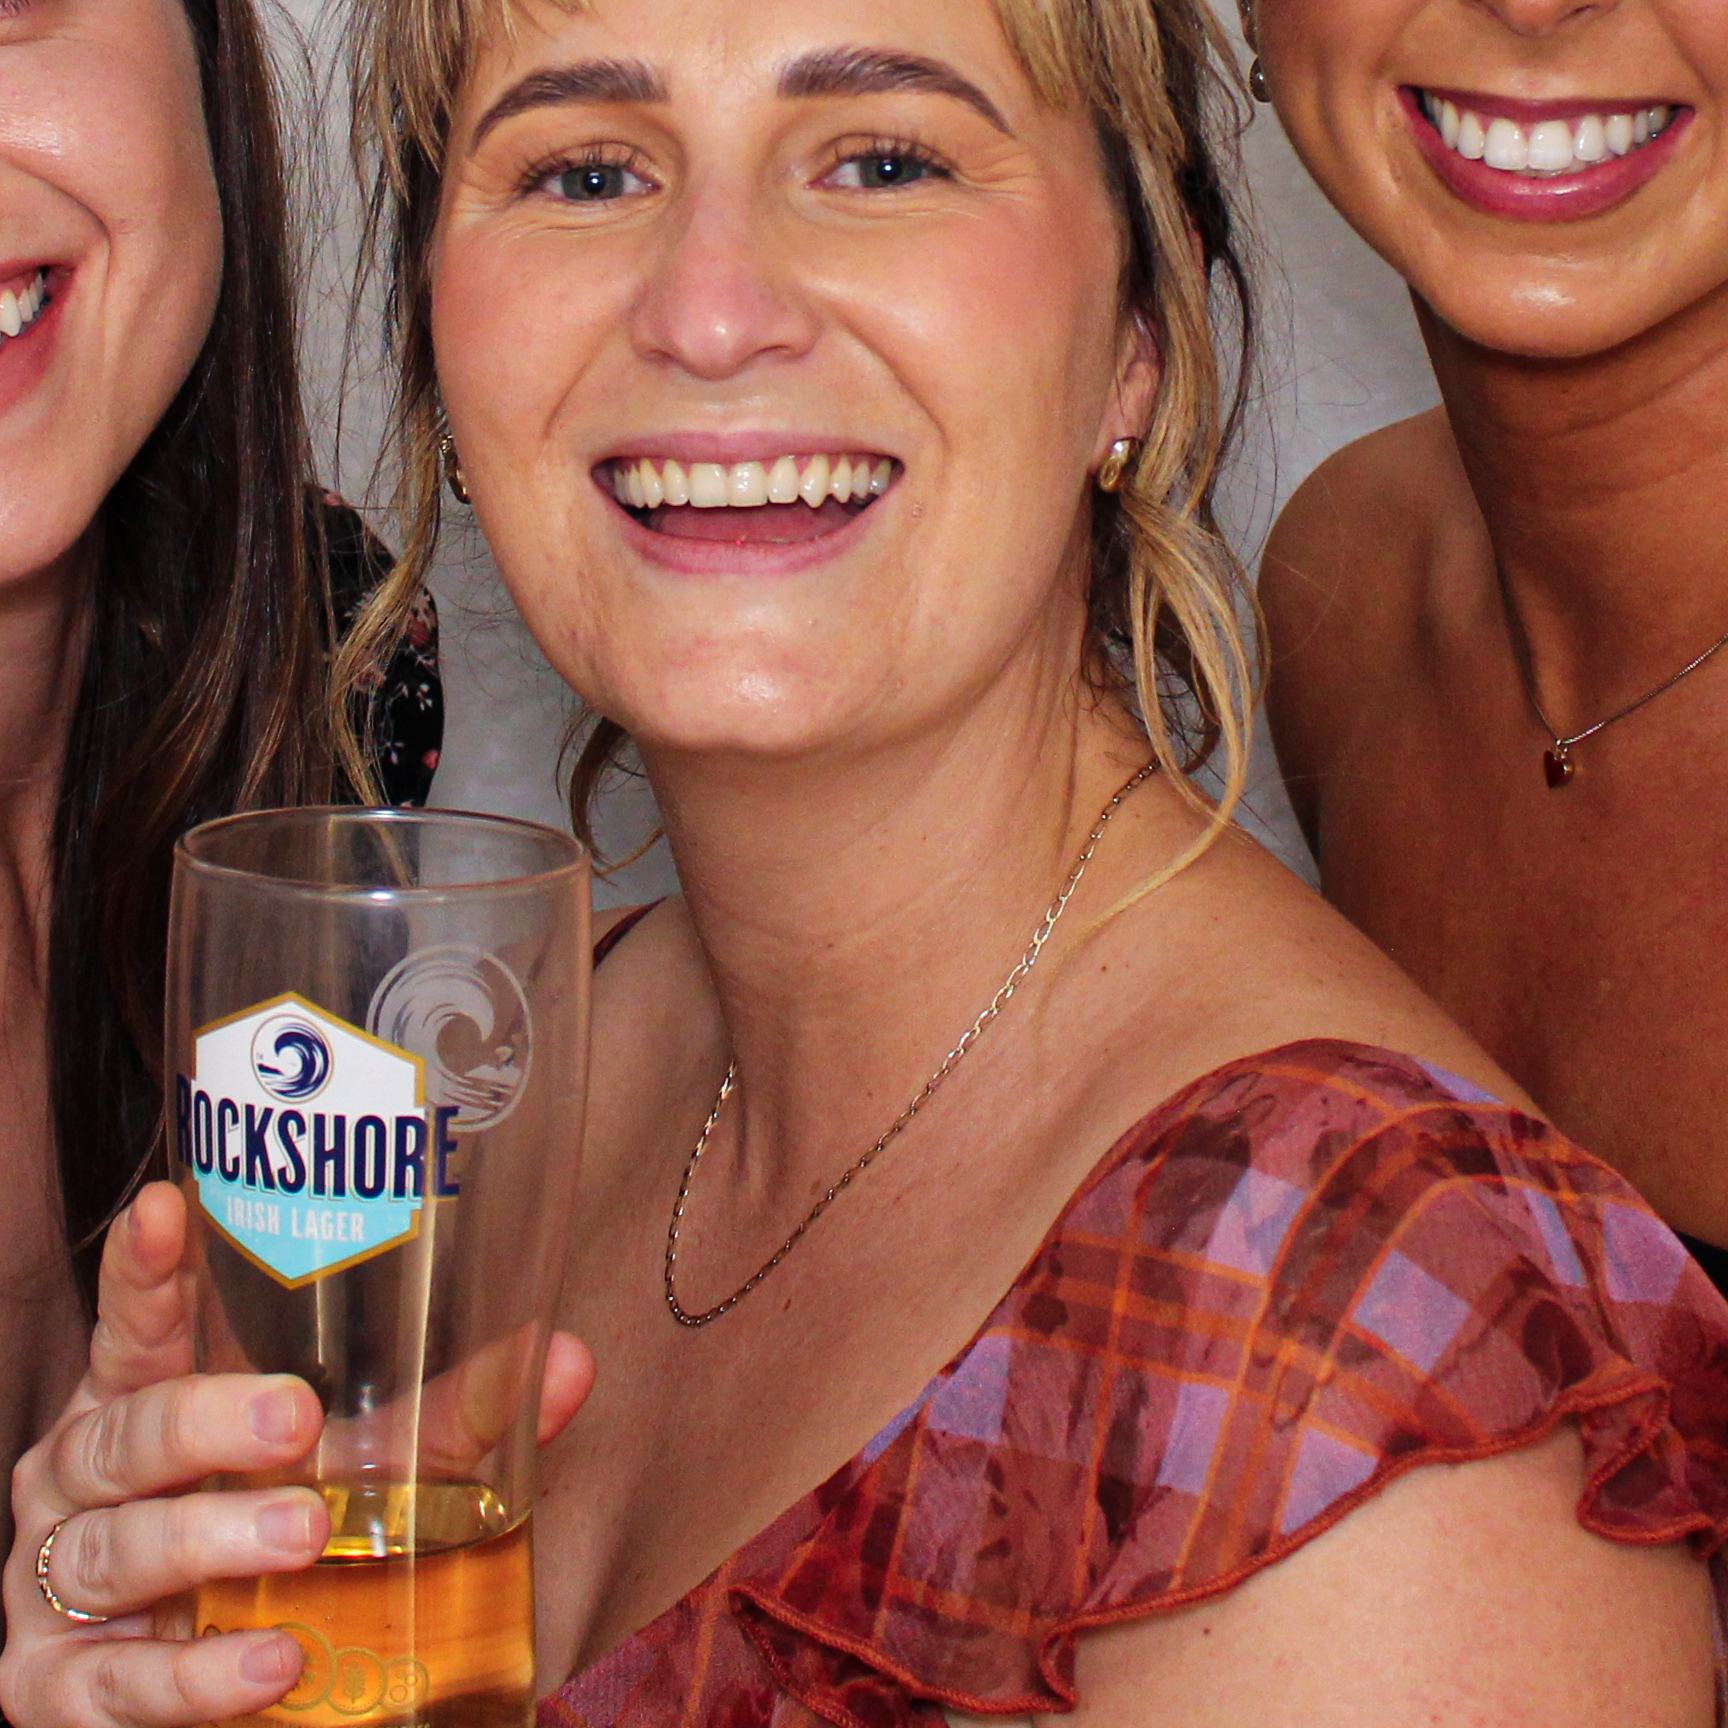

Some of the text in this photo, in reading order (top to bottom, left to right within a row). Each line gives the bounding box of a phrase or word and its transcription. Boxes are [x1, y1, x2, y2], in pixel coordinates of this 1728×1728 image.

[175, 1073, 461, 1200] ROCKSHORE
[226, 1196, 366, 1243] IRISH LAGER
